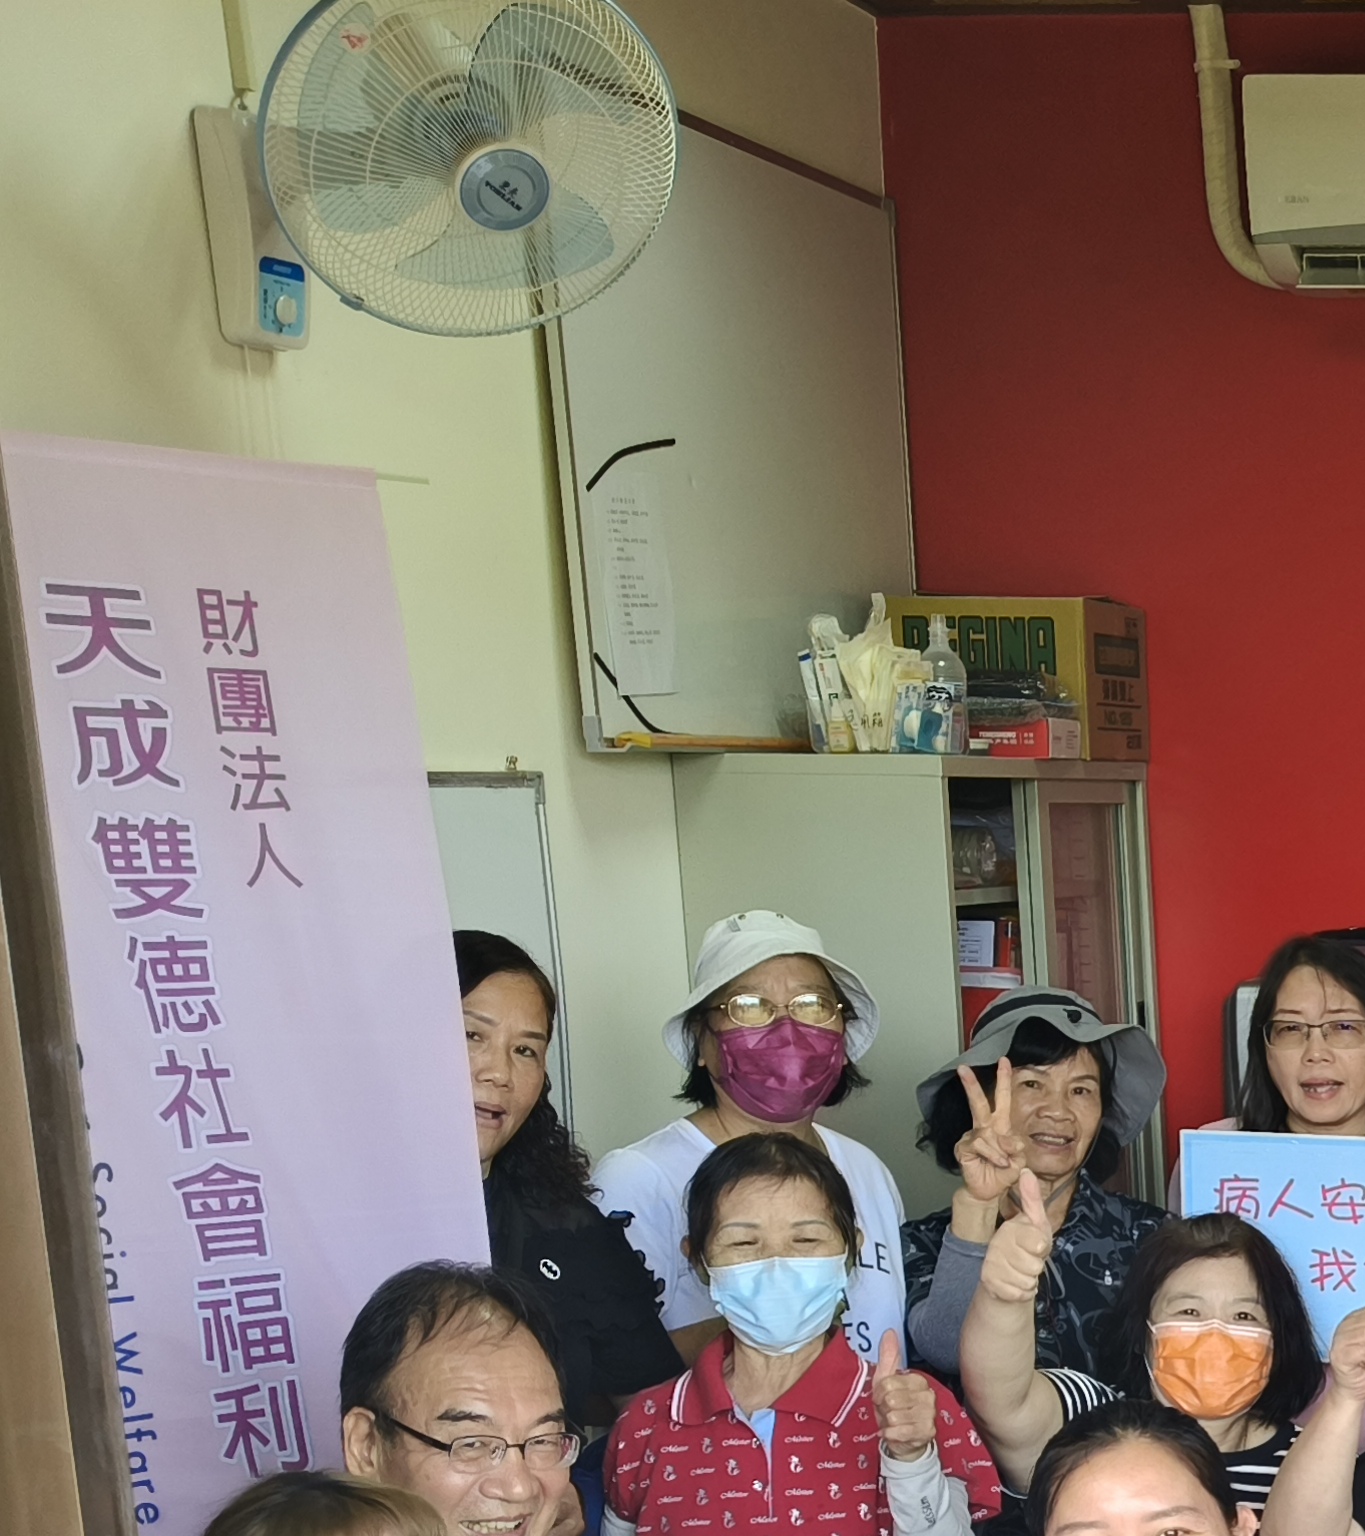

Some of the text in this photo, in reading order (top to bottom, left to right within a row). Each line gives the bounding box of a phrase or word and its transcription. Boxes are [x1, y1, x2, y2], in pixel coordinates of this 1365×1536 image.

[197, 586, 305, 891] 財團法人
[44, 580, 312, 1474] 天成雙德社會福利
[112, 1330, 161, 1527] Welfare
